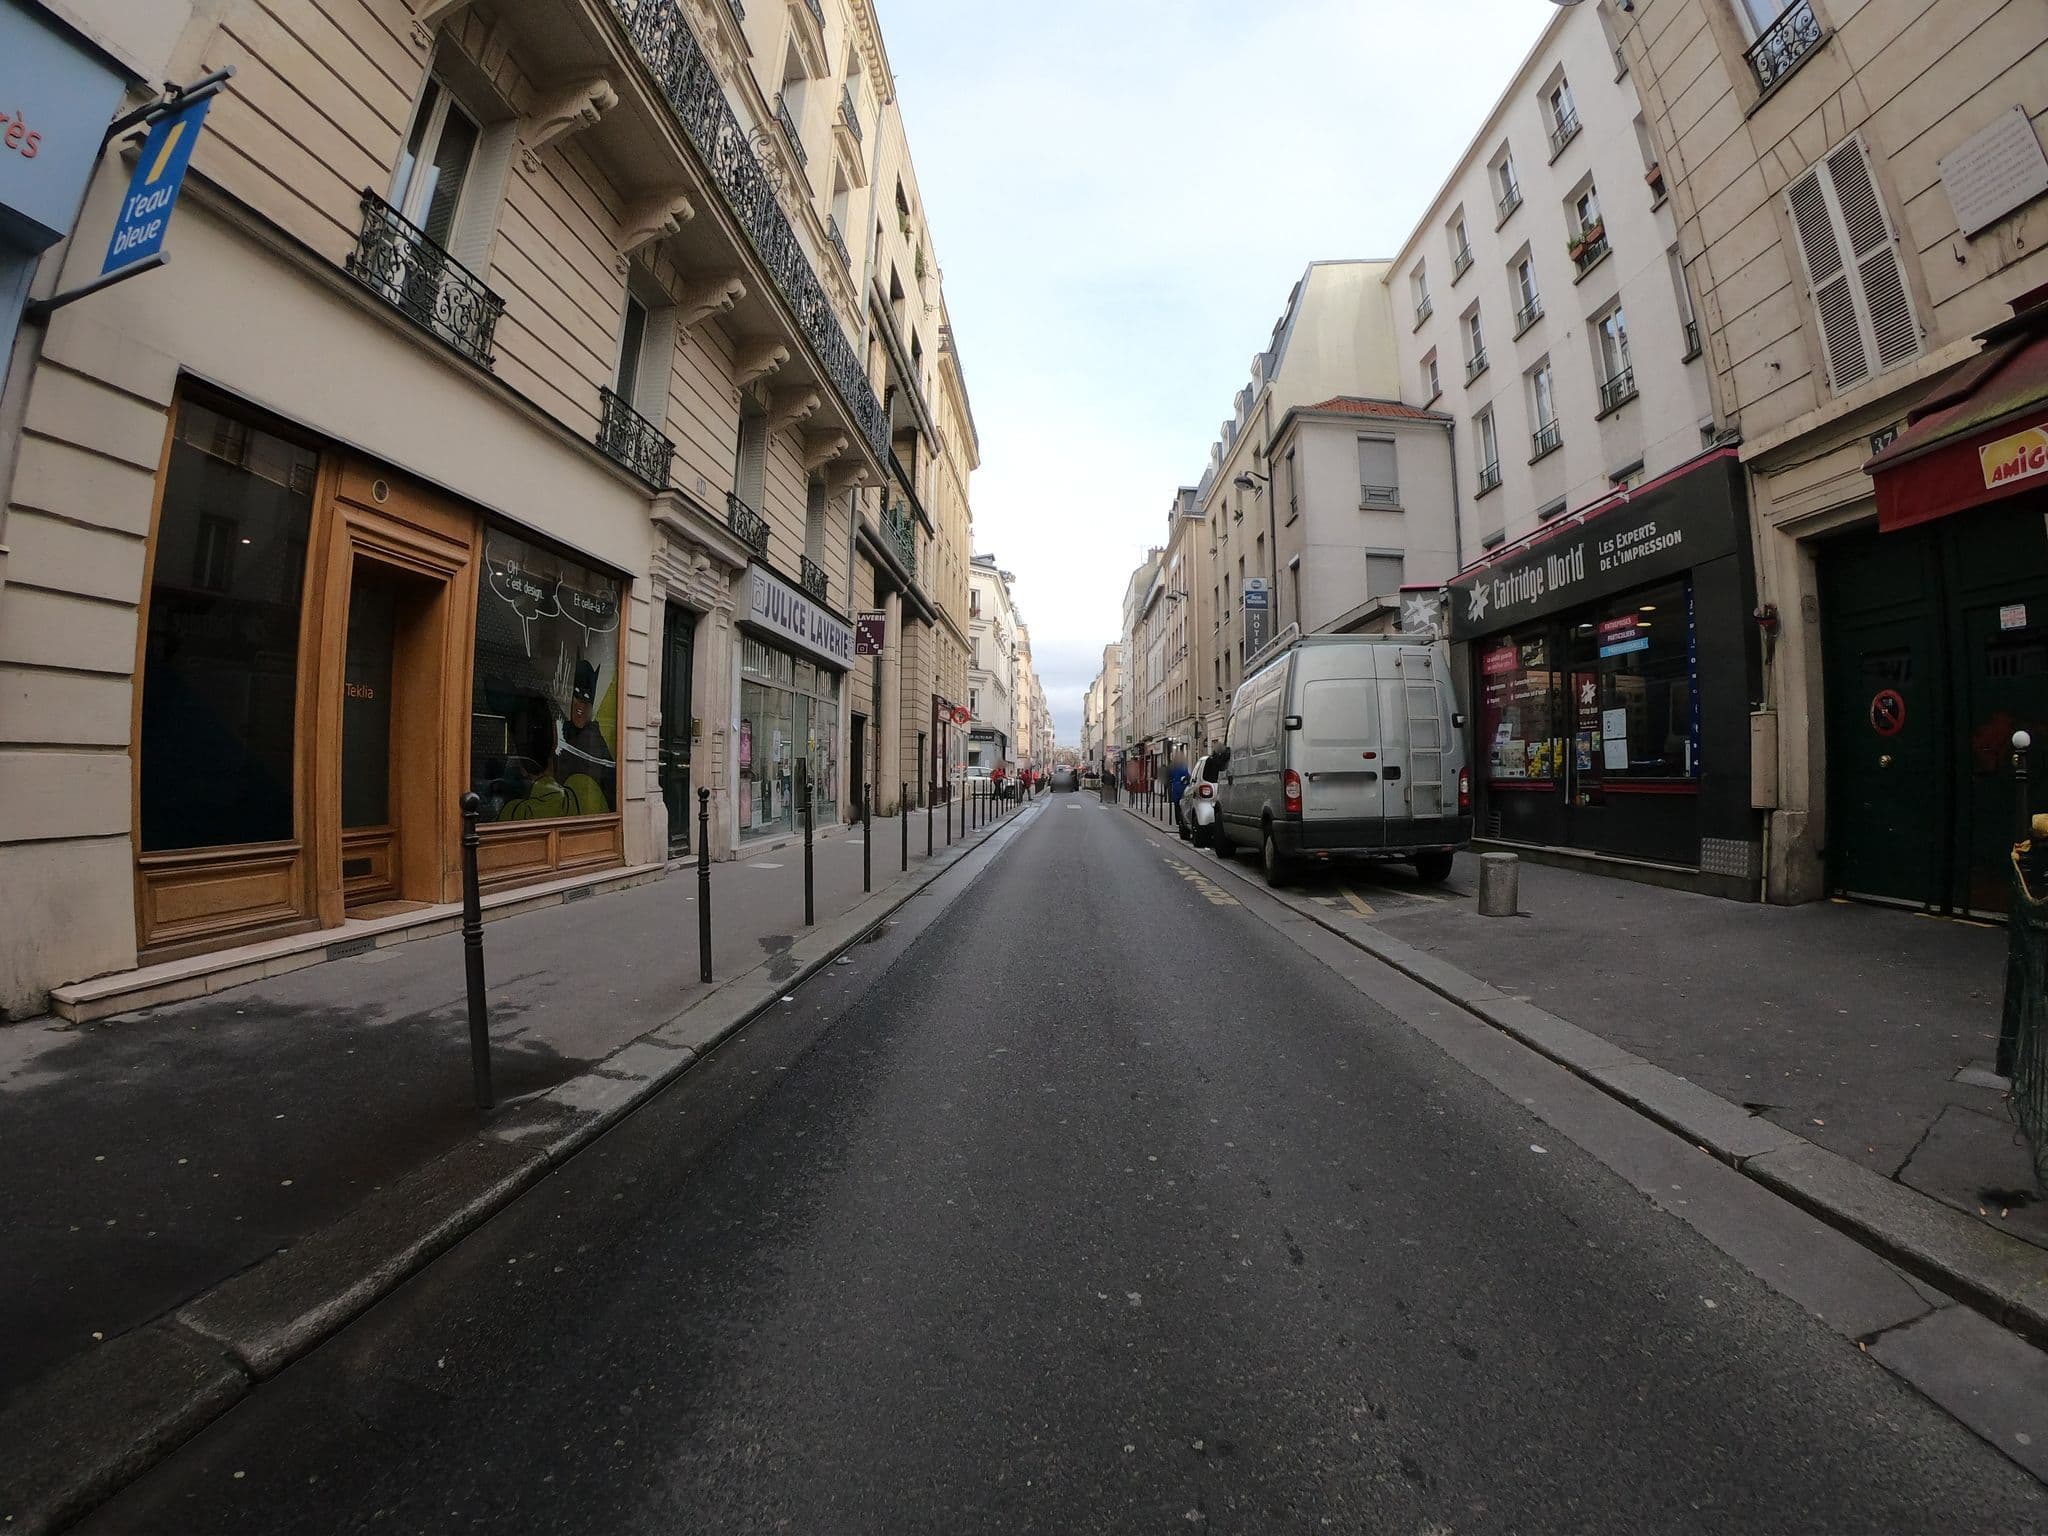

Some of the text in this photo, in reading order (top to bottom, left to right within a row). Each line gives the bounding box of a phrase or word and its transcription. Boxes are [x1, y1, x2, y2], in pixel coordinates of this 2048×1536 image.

[125, 185, 173, 222] l'eau
[113, 218, 162, 254] bleue
[1874, 432, 1893, 454] 37
[1493, 547, 1585, 609] Cartridge World
[764, 583, 848, 660] JULICE LAVERIE
[345, 682, 374, 699] Teklia
